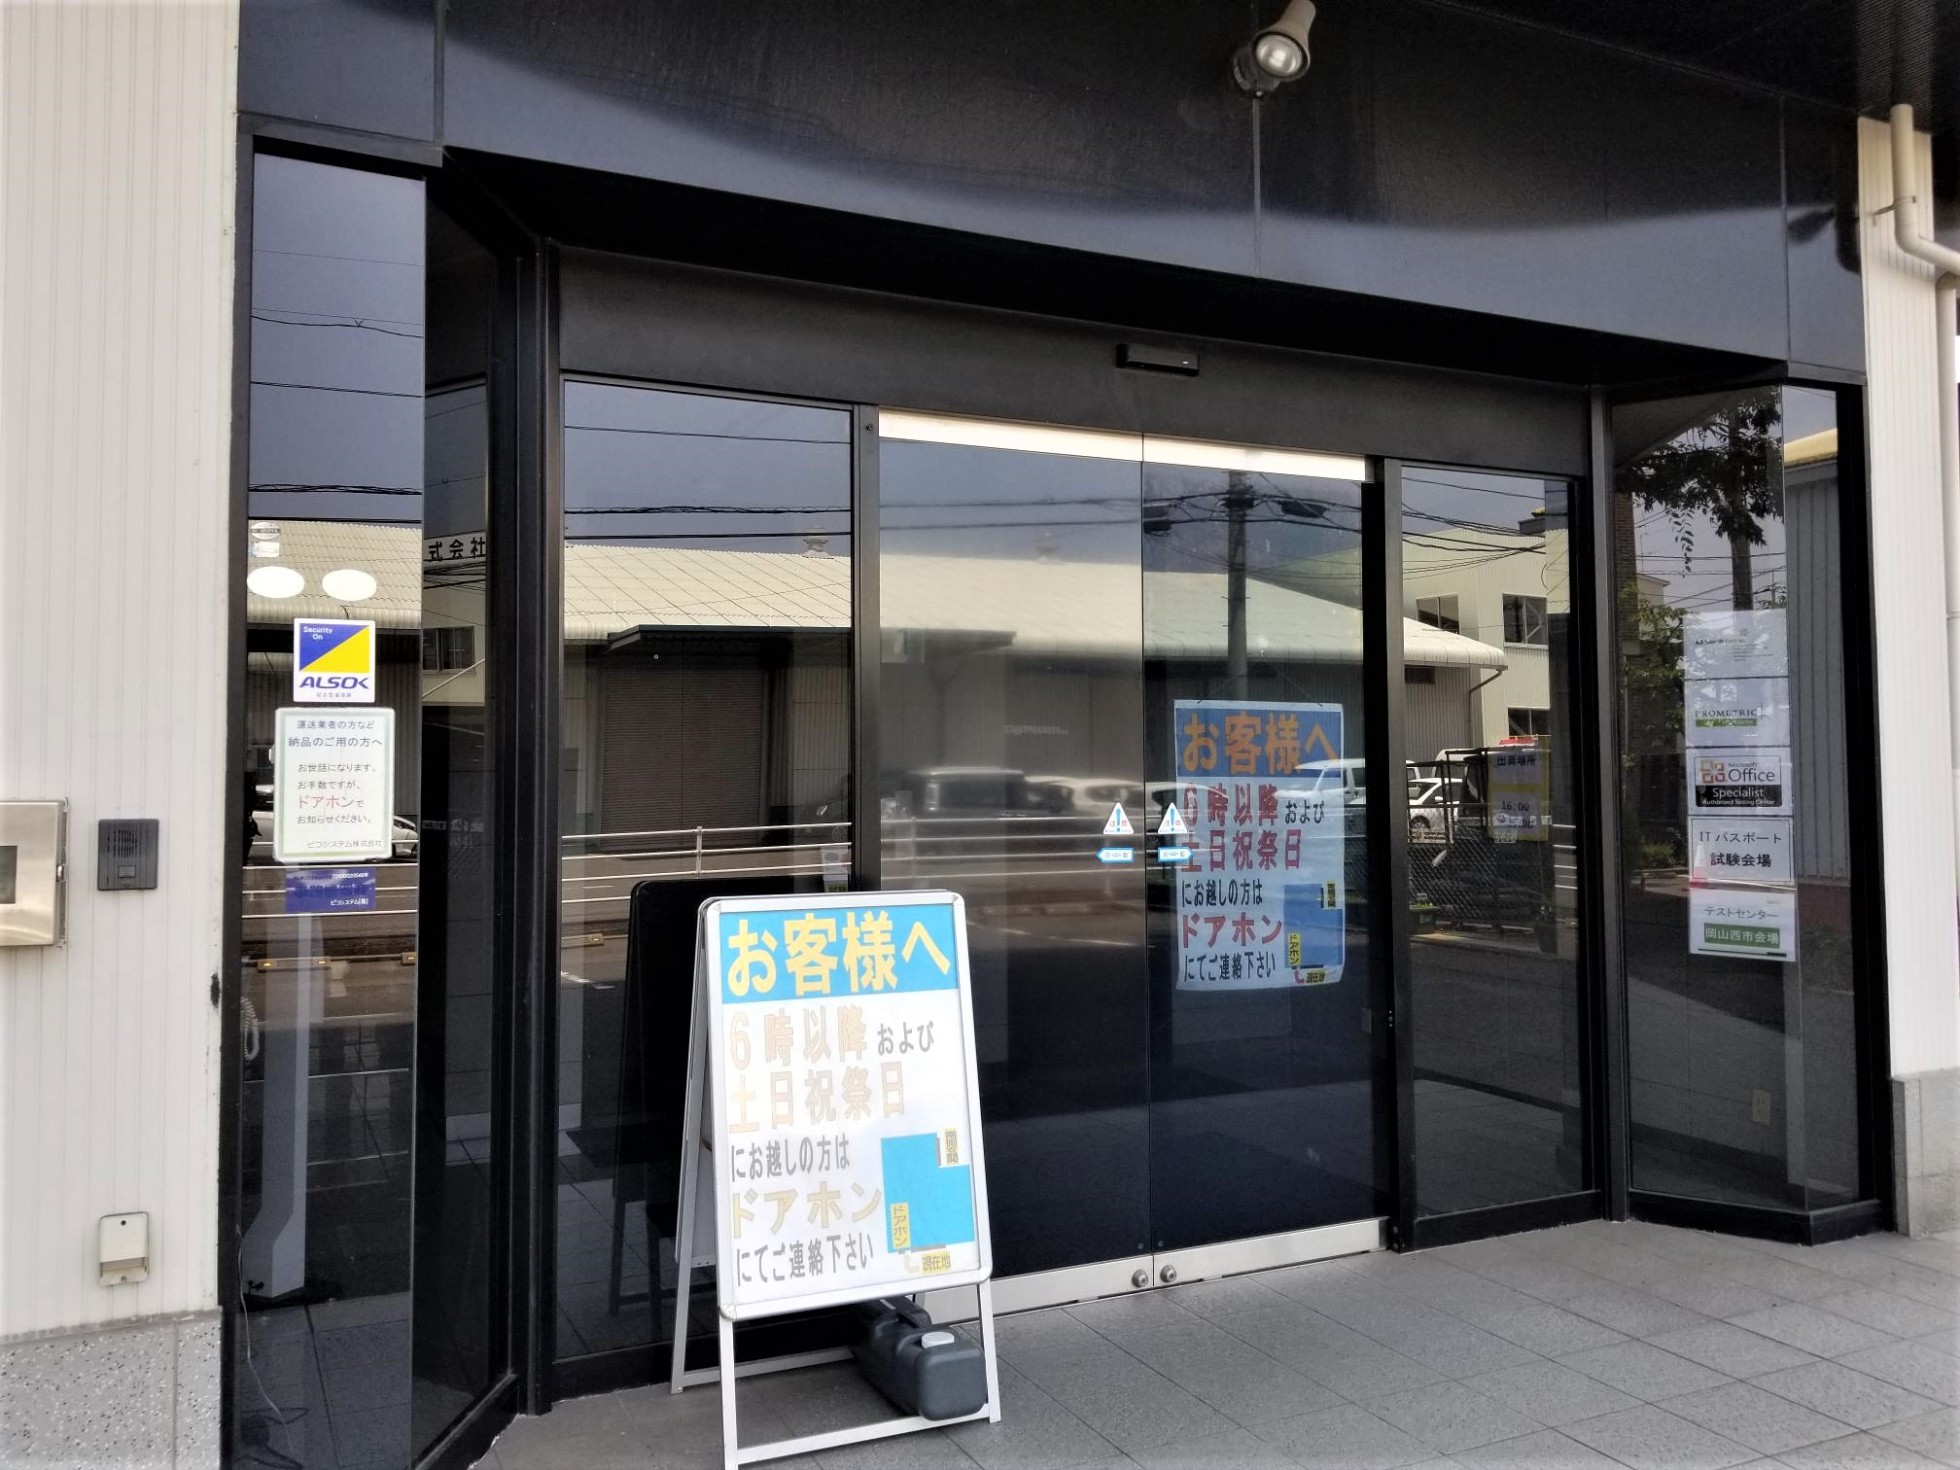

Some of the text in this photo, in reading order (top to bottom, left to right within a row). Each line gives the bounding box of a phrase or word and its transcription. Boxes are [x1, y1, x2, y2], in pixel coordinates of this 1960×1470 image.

[429, 537, 485, 561] 式会社
[303, 626, 333, 634] Security
[299, 676, 370, 690] ALSOK
[297, 720, 374, 729] 運送業者の方など
[288, 736, 383, 748] 納品のご用の方へ
[1183, 711, 1338, 775] お客様へ
[298, 763, 376, 773] お世話になります。
[1728, 768, 1775, 782] Office
[297, 780, 360, 790] お手数ですが、
[1712, 787, 1764, 799] Specialist
[298, 795, 364, 809] ドアホンで
[297, 815, 373, 825] お知らせください。
[307, 839, 383, 848] ピコシステム株式会社
[1700, 831, 1711, 842] IT
[1182, 830, 1301, 872] 土日祝祭日
[1711, 853, 1772, 867] 試験会場
[1181, 878, 1262, 907] にお越しの方は
[1705, 907, 1778, 919] テストセンター
[1183, 911, 1282, 948] ドアホン
[727, 910, 951, 997] お客様へ
[1184, 952, 1275, 982] にてご連絡下さい
[729, 1004, 936, 1070] 6時以降および
[728, 1061, 905, 1134] 土日祝祭日
[731, 1132, 850, 1183] にお越しの方は
[732, 1180, 882, 1240] ドアホン
[893, 1204, 908, 1248] ドアホン
[736, 1232, 874, 1287] にてご連絡下さい
[922, 1253, 951, 1270] 現在地
